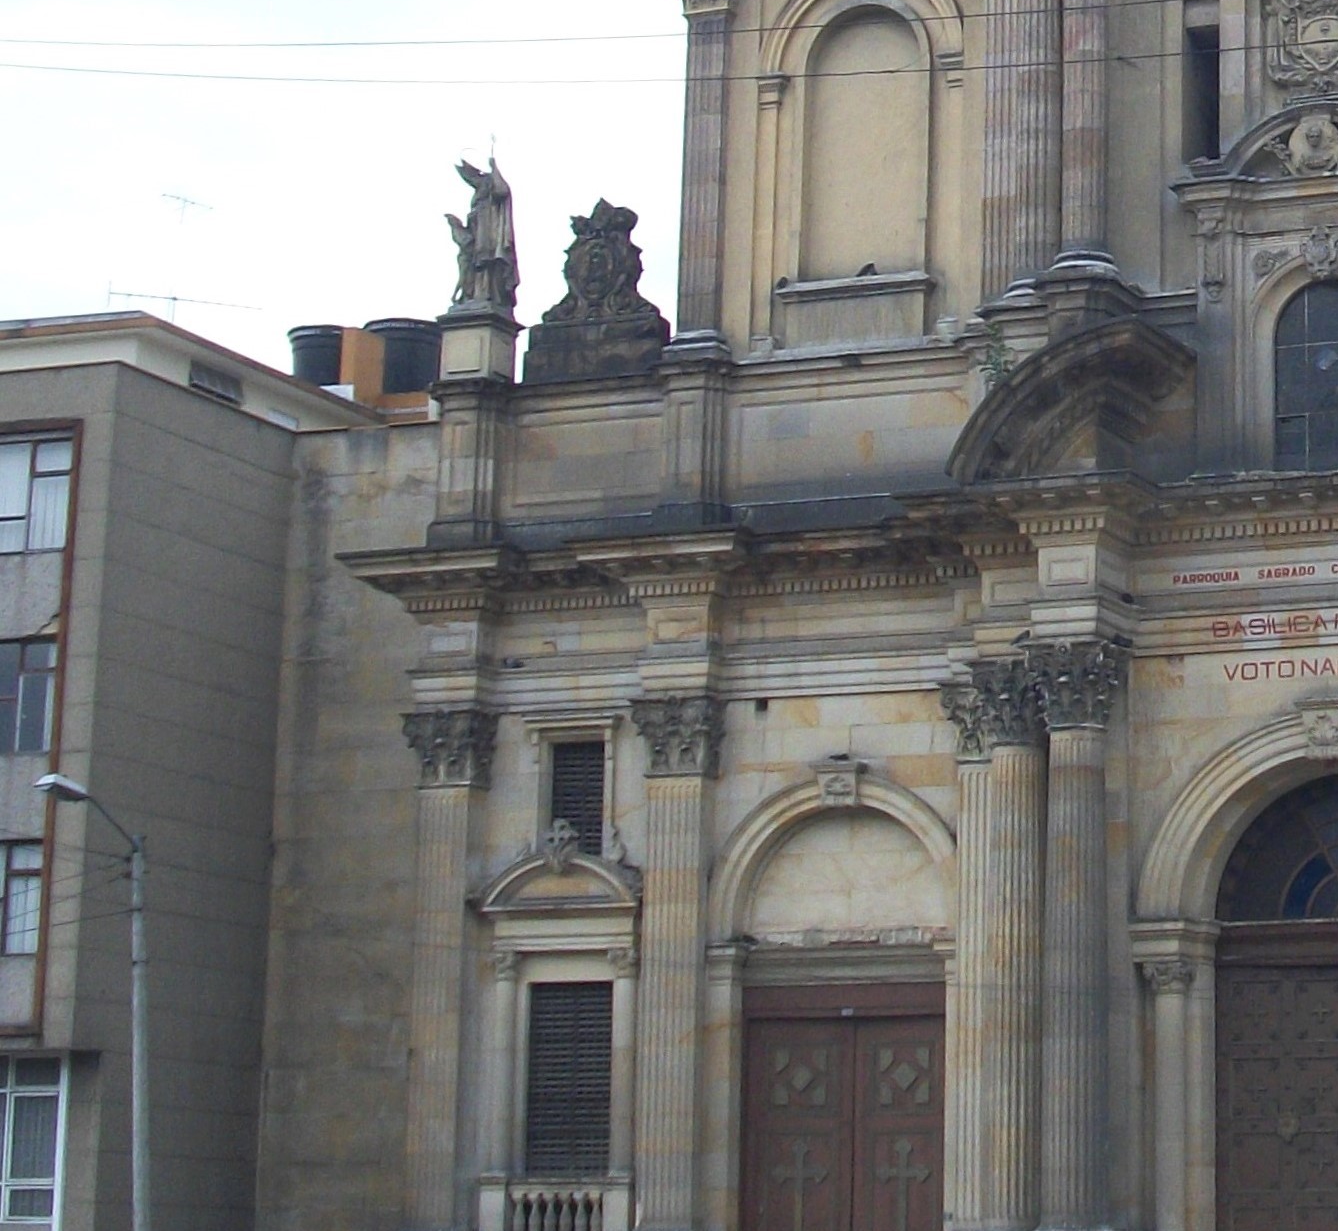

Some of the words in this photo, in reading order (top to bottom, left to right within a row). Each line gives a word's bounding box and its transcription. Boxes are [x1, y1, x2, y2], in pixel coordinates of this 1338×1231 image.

[1172, 570, 1240, 585] PARROQUIA
[1257, 565, 1316, 580] SAGRADO
[1212, 614, 1328, 638] BASÍLICA
[1223, 660, 1296, 681] VOTO
